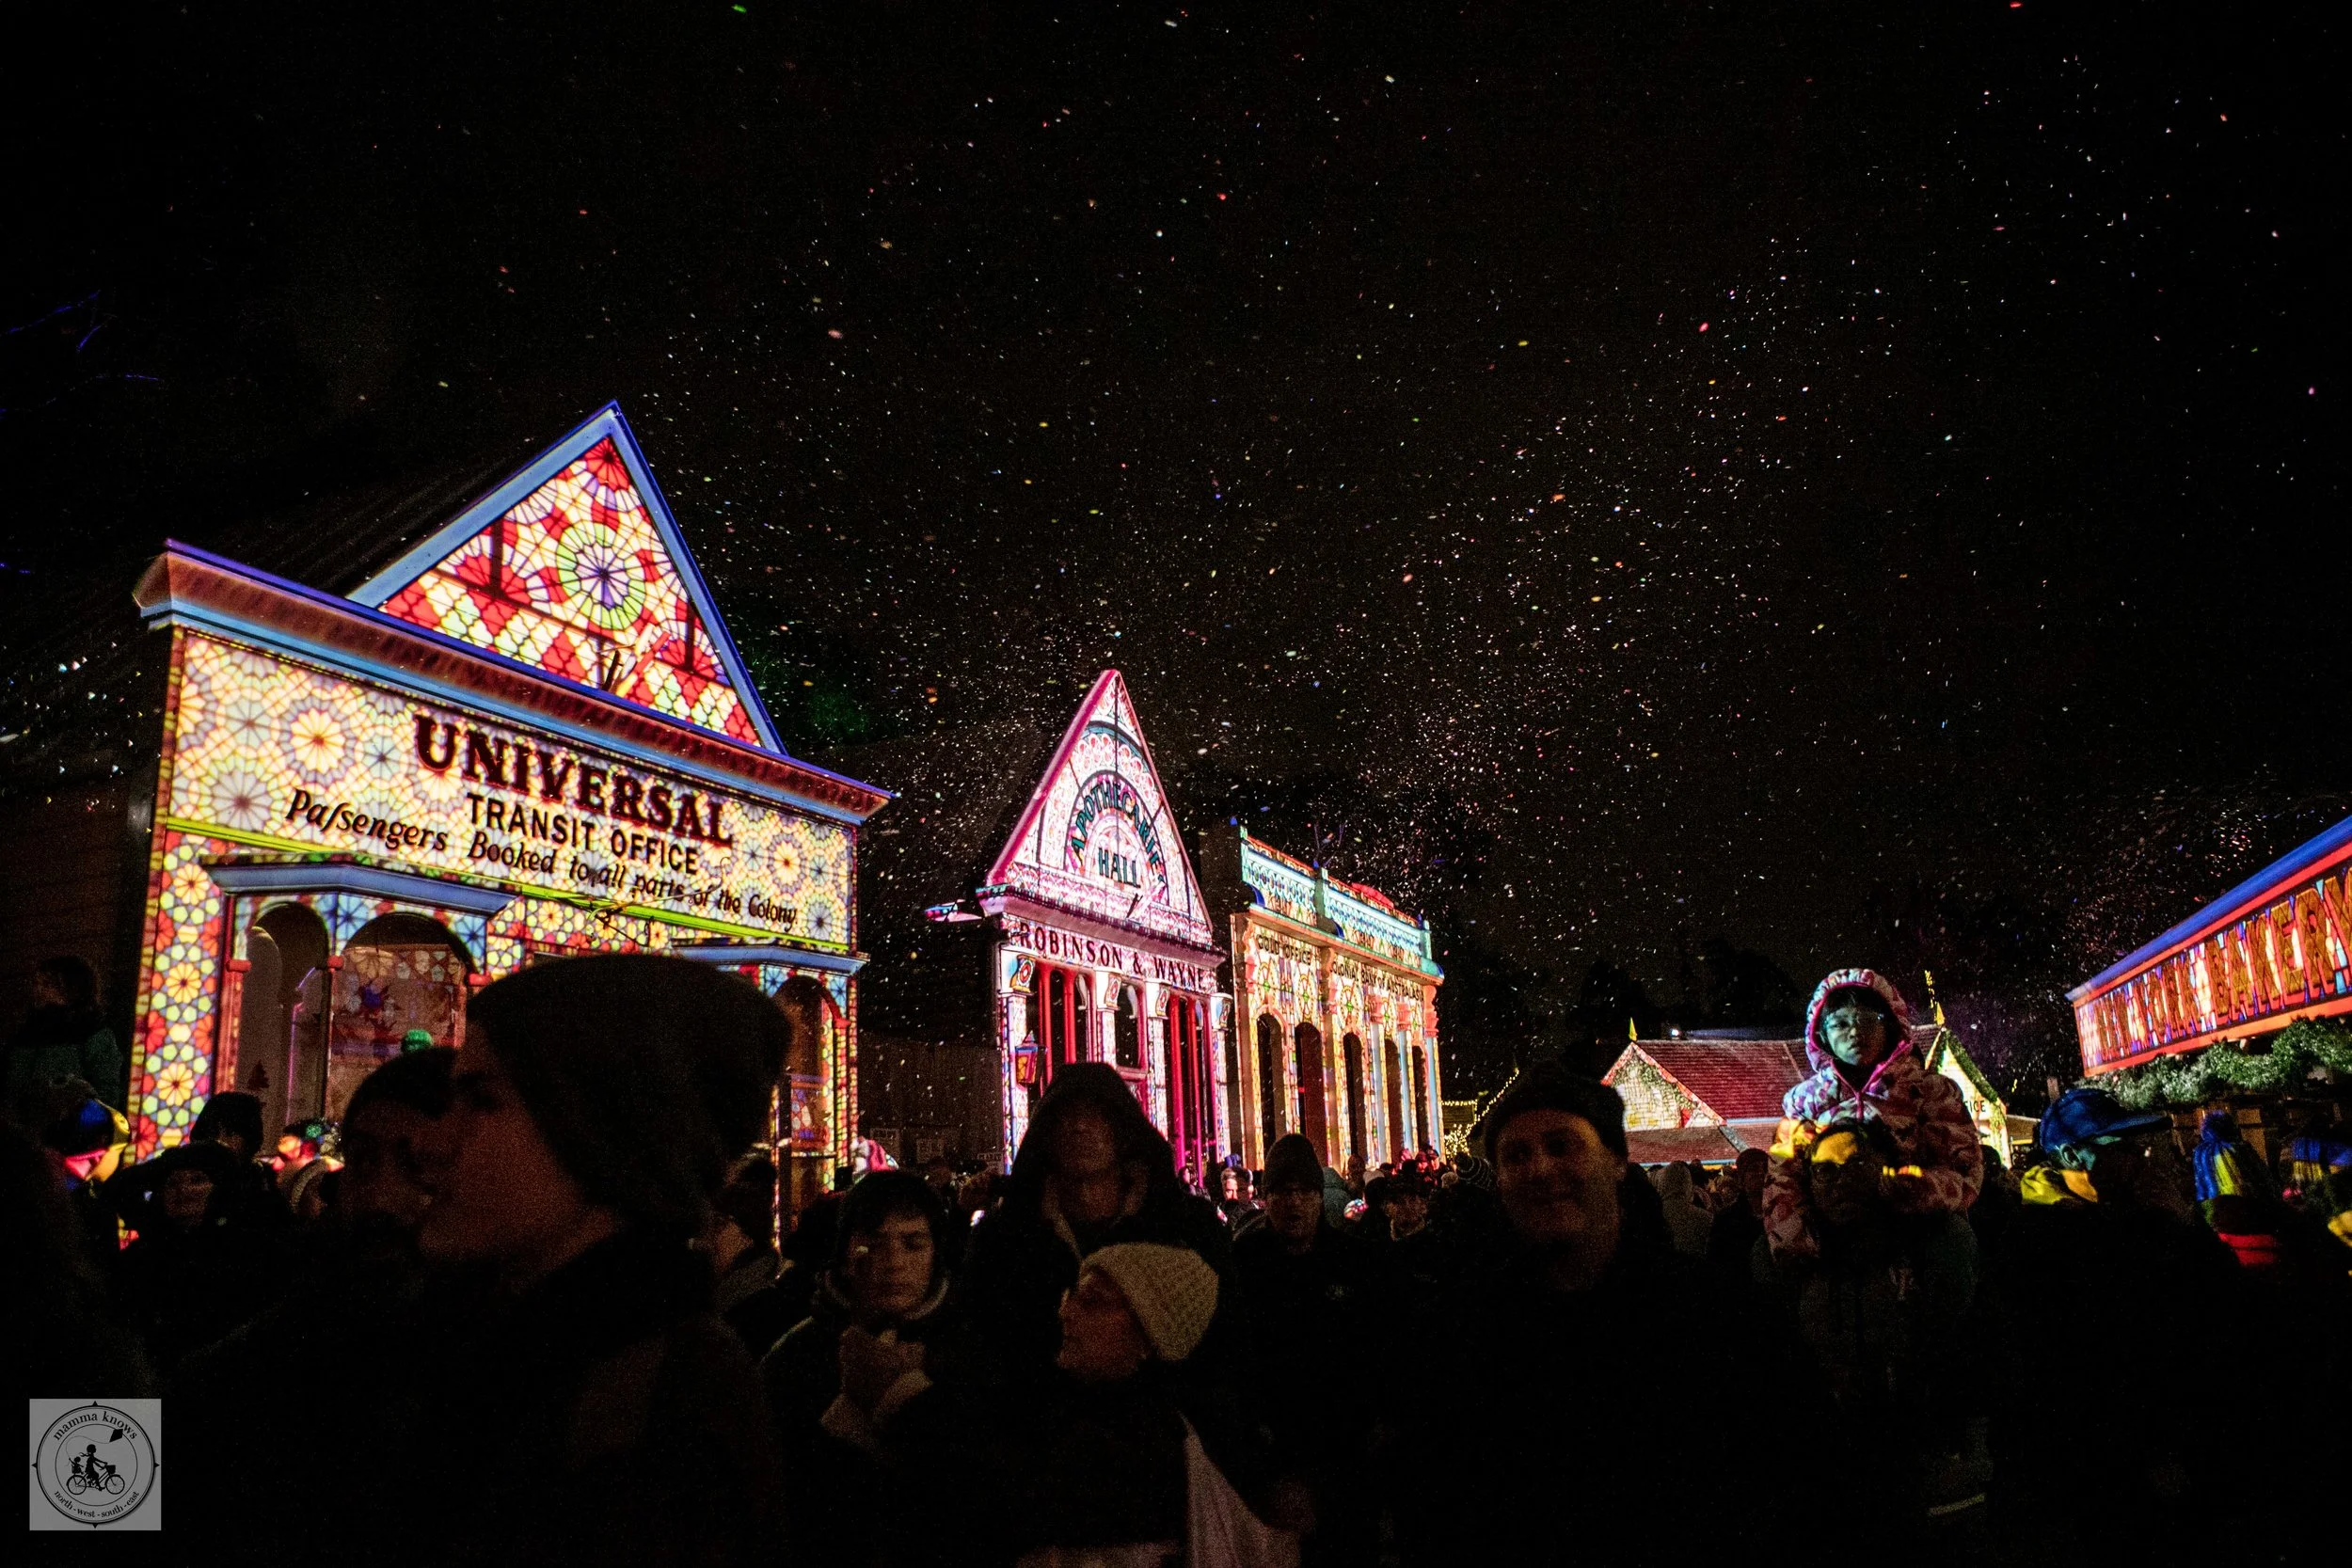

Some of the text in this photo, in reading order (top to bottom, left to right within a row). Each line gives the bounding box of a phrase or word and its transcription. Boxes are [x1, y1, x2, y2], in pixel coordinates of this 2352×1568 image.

[415, 715, 732, 848] UNIVERSAL
[468, 792, 698, 875] TRANSIT OFFICE
[1098, 847, 1140, 888] HALL
[468, 831, 556, 875] Booked
[569, 855, 590, 881] to
[598, 863, 626, 889] all
[633, 873, 684, 901] parts
[691, 884, 713, 907] of
[718, 889, 741, 913] the
[1020, 922, 1206, 990] ROBINSON & WAYNE
[1257, 934, 1311, 966] GOLD OFFICE
